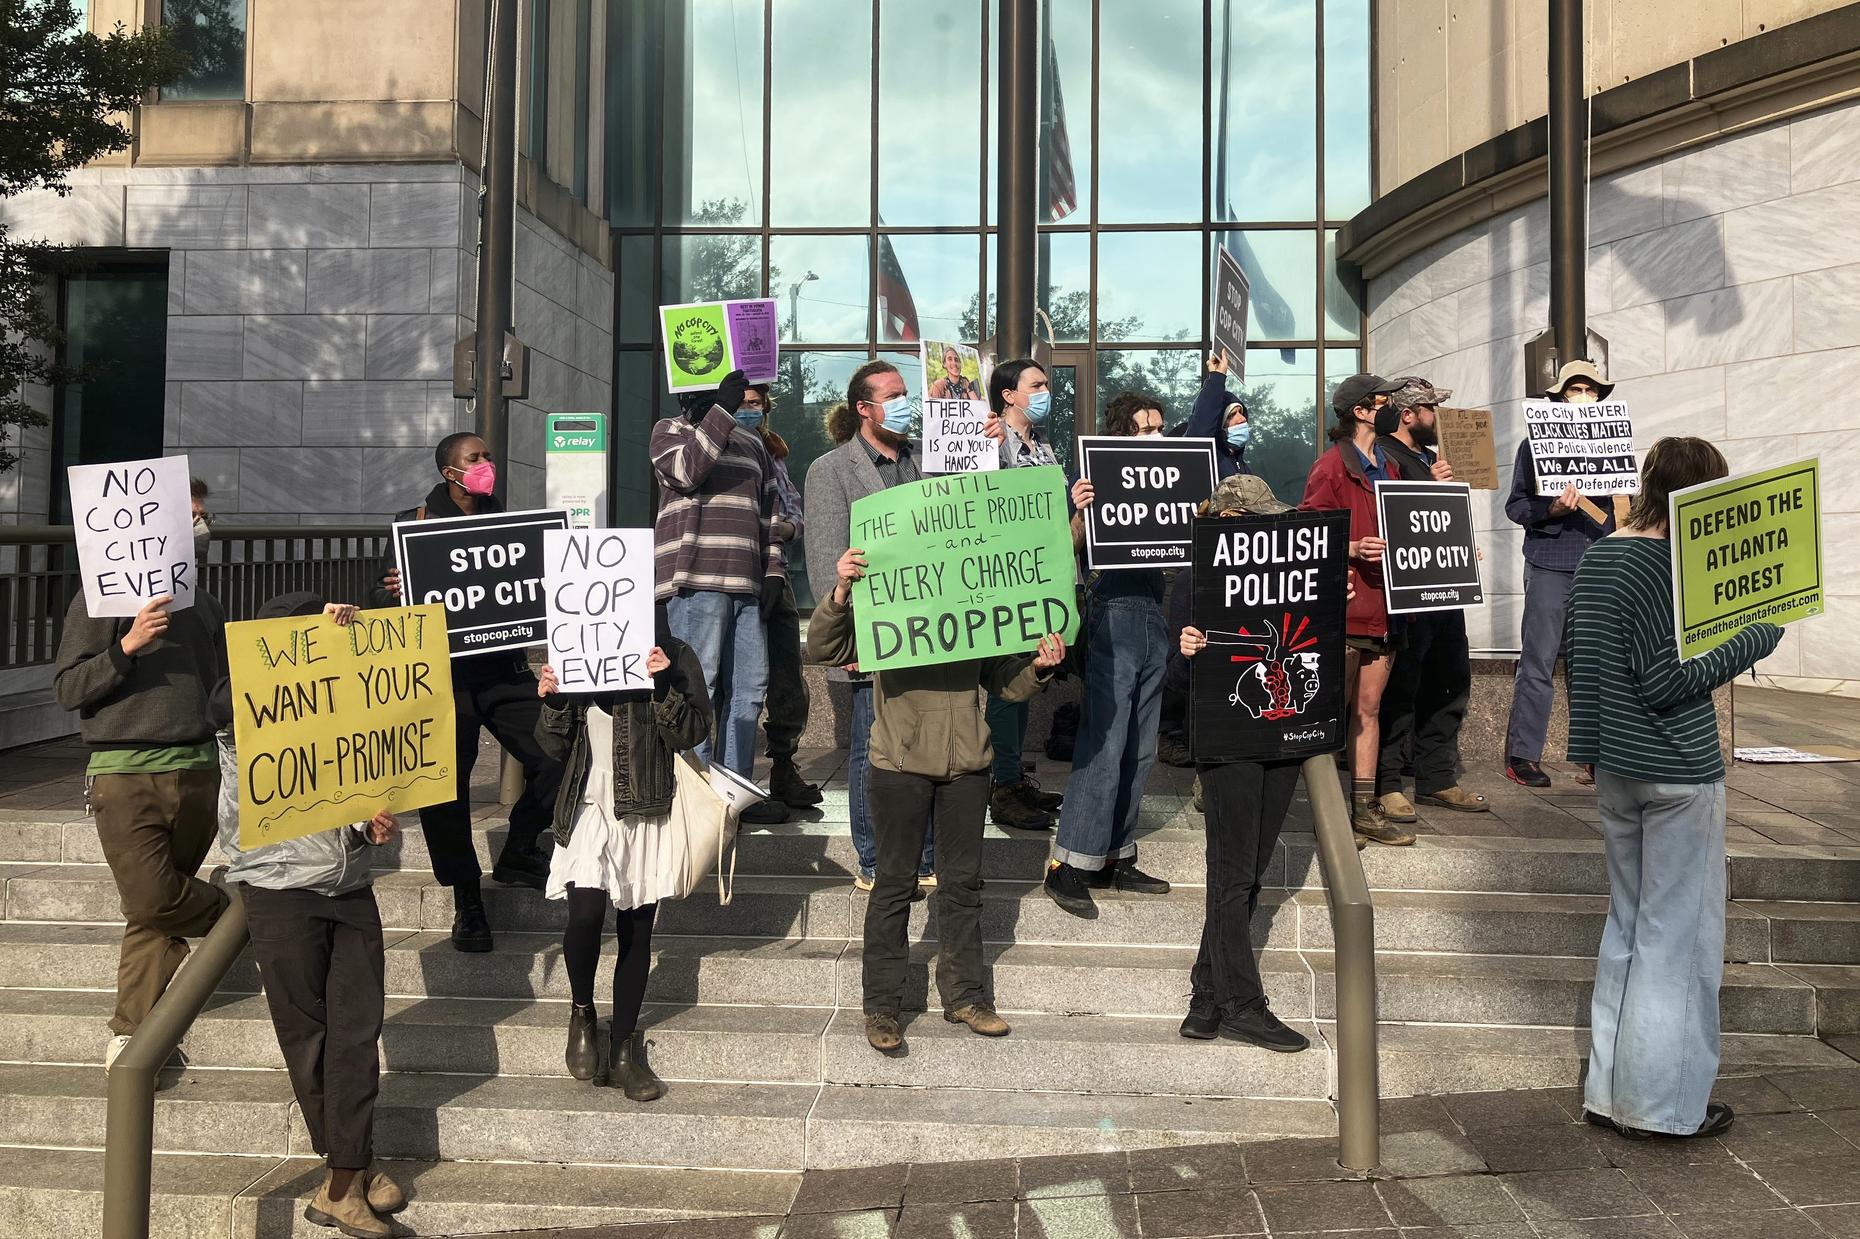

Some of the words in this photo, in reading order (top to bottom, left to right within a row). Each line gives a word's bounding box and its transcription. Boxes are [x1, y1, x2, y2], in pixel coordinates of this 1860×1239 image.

[1227, 282, 1242, 311] STOP
[674, 323, 685, 339] NO
[686, 317, 702, 328] COP
[702, 320, 718, 335] CITY
[1220, 306, 1232, 331] COP
[1232, 320, 1244, 348] CITY
[925, 400, 974, 418] THEIR
[1526, 407, 1548, 421] Cop
[1552, 407, 1574, 421] City
[1578, 404, 1626, 418] NEVER!
[567, 437, 596, 447] relay
[942, 420, 984, 436] BLOOD
[1532, 423, 1562, 439] BLACK
[1563, 423, 1589, 439] LIVES
[1590, 422, 1631, 438] MATTER
[930, 439, 940, 452] IS
[948, 440, 962, 453] ON
[968, 440, 994, 454] YOUR
[1533, 442, 1554, 454] END
[1558, 442, 1586, 454] Police
[1588, 442, 1634, 454] Violence!
[944, 454, 978, 471] HANDS
[1539, 460, 1562, 473] We
[1566, 459, 1597, 472] Are
[1602, 458, 1635, 471] ALL
[102, 468, 156, 498] NO
[921, 474, 1000, 498] UNTIL
[1121, 466, 1180, 489] STOP
[1576, 478, 1639, 490] Defenders!
[86, 502, 159, 532] COP
[857, 513, 897, 541] THE
[911, 500, 976, 536] WHOLE
[988, 492, 1052, 524] PROJECT
[1101, 503, 1148, 526] COP
[1409, 510, 1451, 533] STOP
[1690, 498, 1762, 541] DEFEND
[1767, 487, 1803, 517] THE
[106, 535, 168, 561] CITY
[450, 542, 526, 572] STOP
[561, 535, 626, 572] NO
[1131, 546, 1184, 558] stopcop.city
[1212, 526, 1328, 567] ABOLISH
[1396, 547, 1431, 570] COP
[1436, 546, 1469, 568] CITY
[1706, 527, 1788, 572] ATLANTA
[98, 561, 189, 598] EVER
[494, 577, 546, 605] CIT
[868, 562, 945, 607] EVERY
[961, 547, 1052, 592] CHARGE
[1225, 568, 1318, 607] POLICE
[1714, 563, 1784, 605] FOREST
[554, 578, 635, 616] COP
[1420, 589, 1459, 602] stopcop.city
[872, 598, 1070, 660] DROPPED
[1685, 592, 1819, 645] defendtheatlantaforest.com
[257, 625, 328, 670] WE
[348, 613, 427, 656] DON'T
[464, 626, 533, 644] stopcop.city
[552, 620, 629, 654] CITY
[563, 654, 645, 686] EVER
[245, 676, 340, 728] WANT
[357, 662, 433, 709] YOUR
[1283, 729, 1325, 742] #StopCopCity
[248, 718, 436, 806] CON-PROMISE
